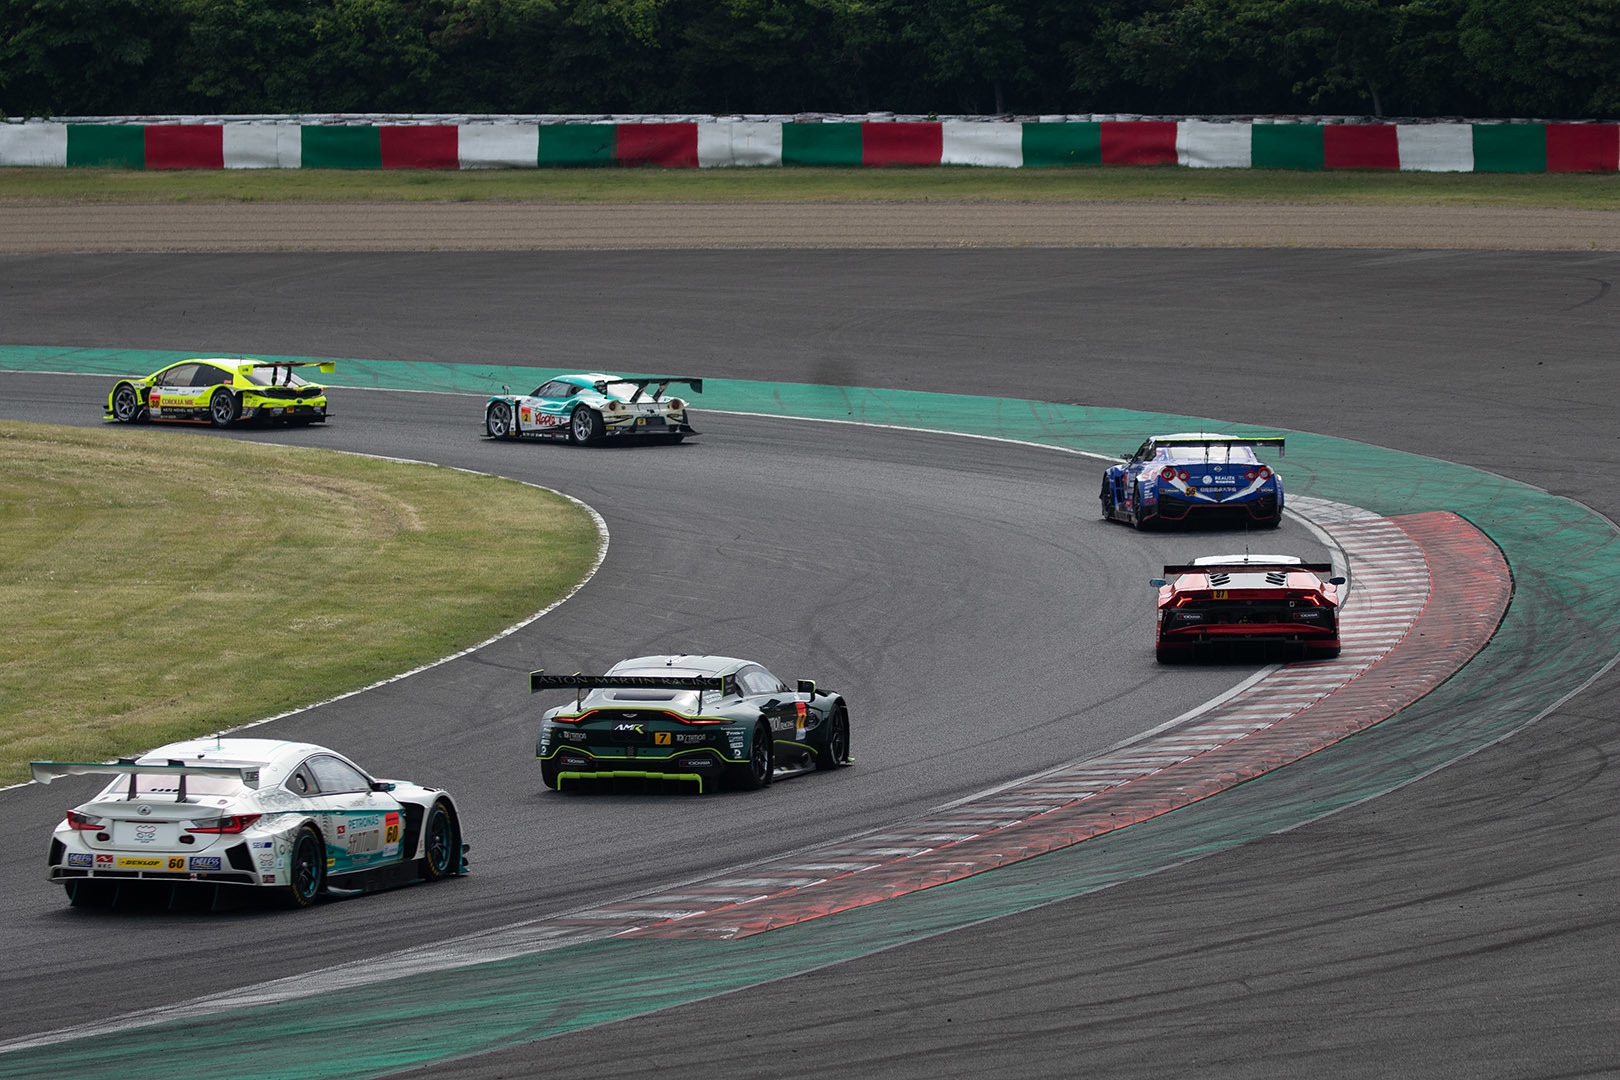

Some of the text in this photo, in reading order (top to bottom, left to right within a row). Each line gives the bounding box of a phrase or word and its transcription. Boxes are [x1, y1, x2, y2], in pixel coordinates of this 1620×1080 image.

[151, 400, 160, 408] 30
[523, 413, 529, 422] 2
[1185, 487, 1197, 496] 56
[1215, 591, 1226, 599] 87
[539, 676, 588, 684] ASTON
[661, 677, 720, 686] RACING
[614, 724, 645, 734] AMR
[658, 733, 668, 744] 7
[348, 814, 380, 830] PETRONAS
[386, 825, 399, 843] 60
[69, 854, 93, 863] ENDLESS
[191, 856, 220, 865] ENDLESS
[168, 858, 184, 869] 60
